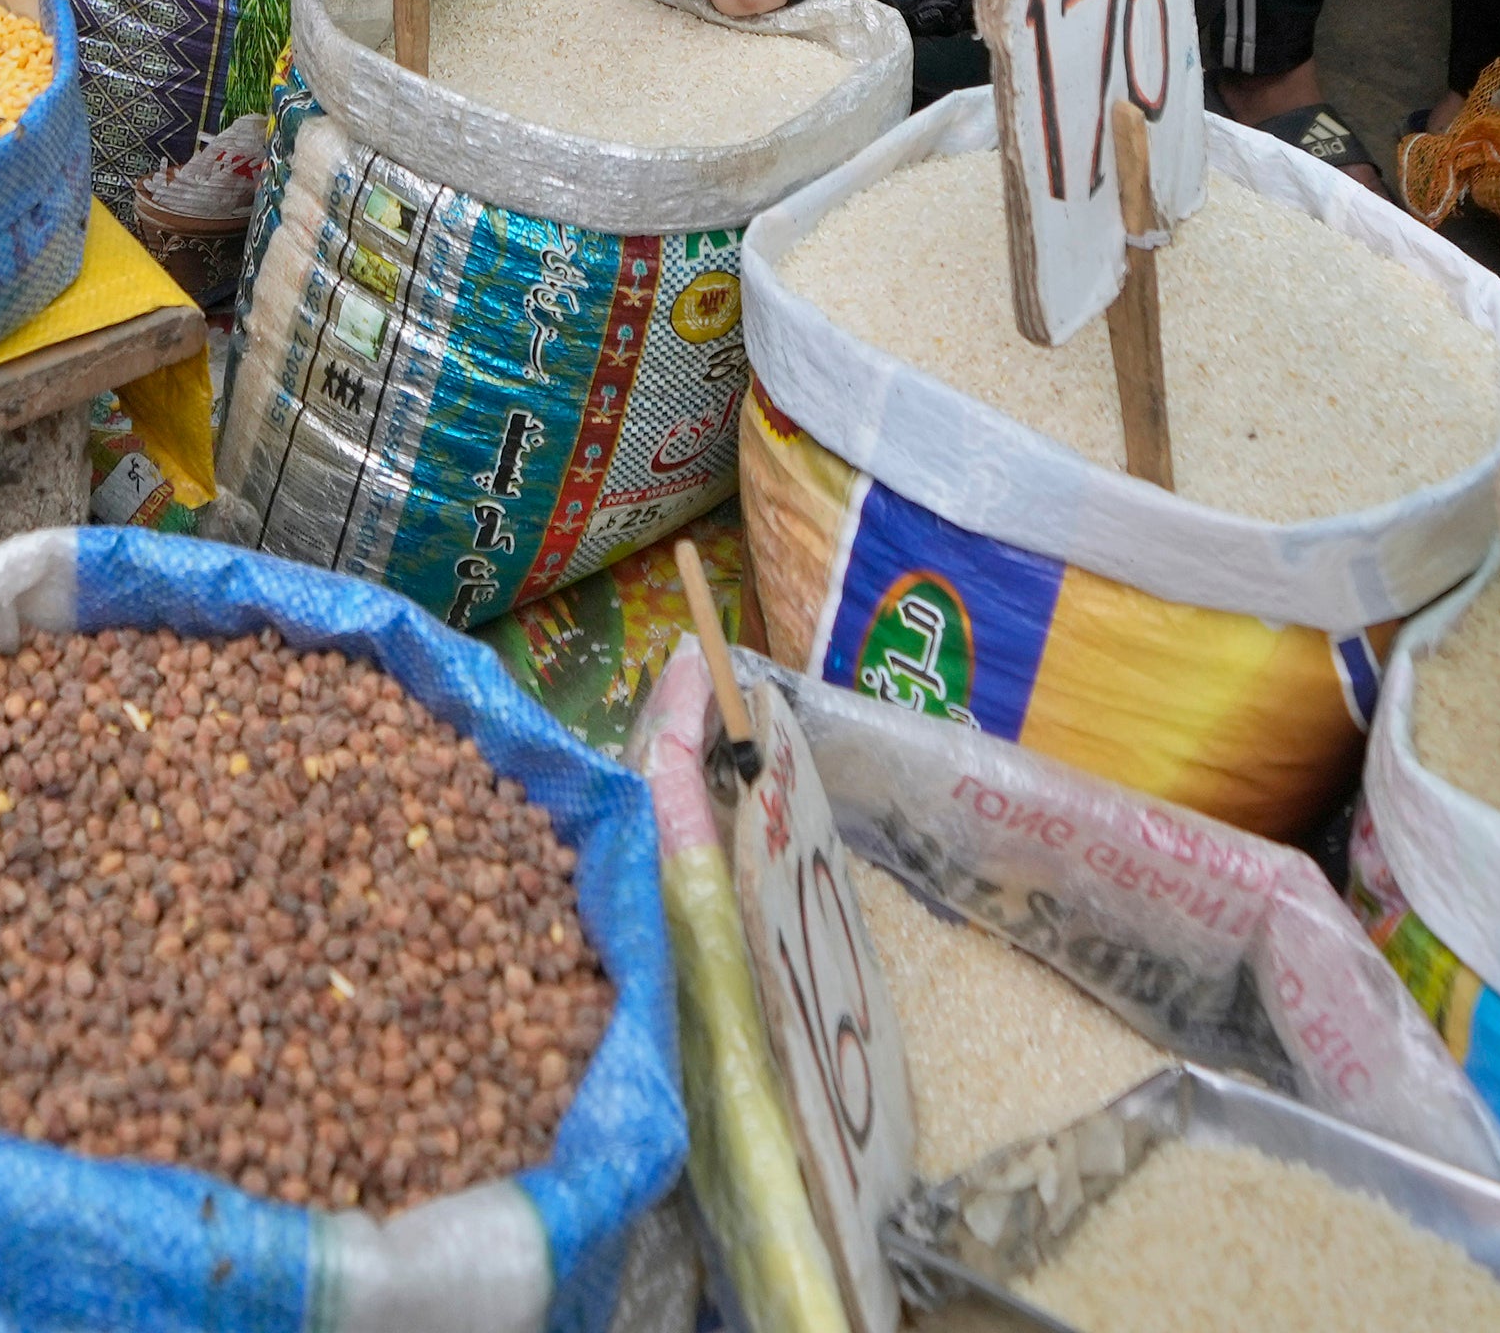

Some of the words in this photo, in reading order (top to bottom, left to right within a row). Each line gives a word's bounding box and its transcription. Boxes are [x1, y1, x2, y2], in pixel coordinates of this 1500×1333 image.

[697, 289, 731, 310] AHT
[473, 407, 546, 501] پسند
[606, 488, 643, 506] NET
[473, 501, 516, 556] کی
[623, 501, 661, 529] 25
